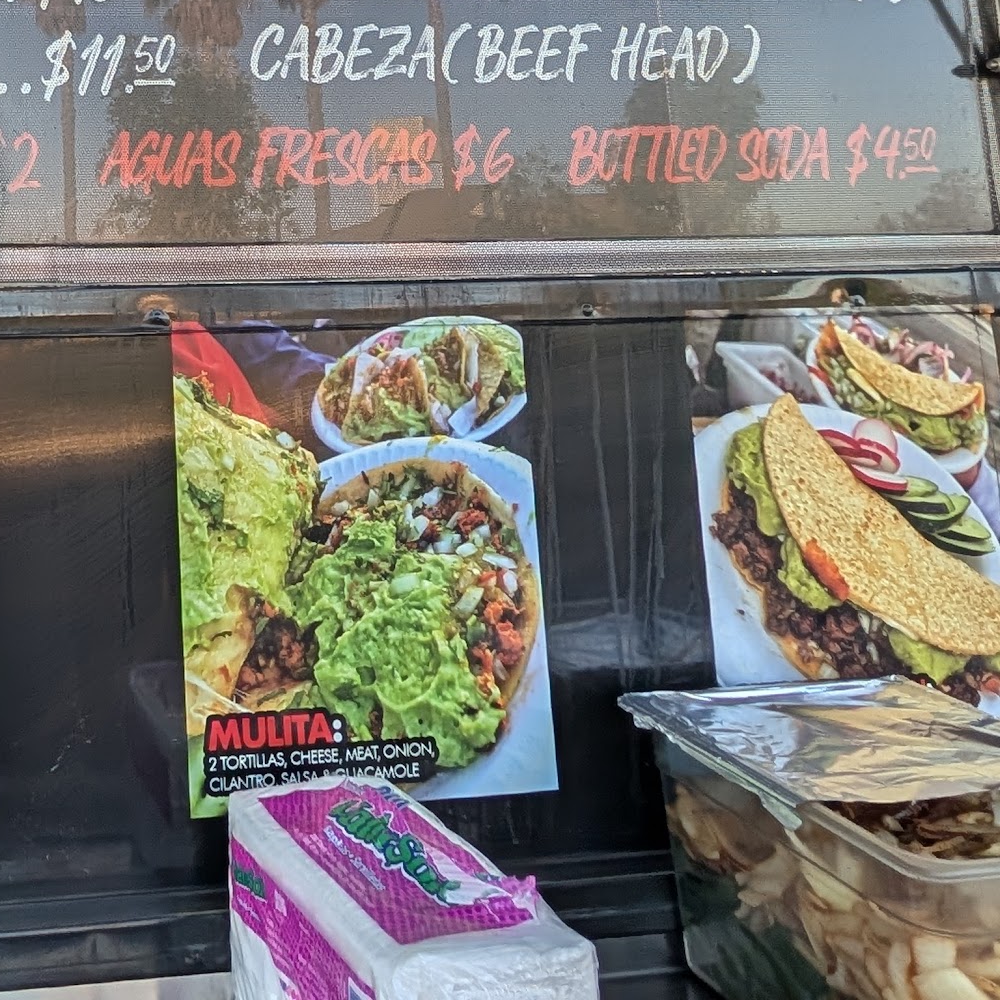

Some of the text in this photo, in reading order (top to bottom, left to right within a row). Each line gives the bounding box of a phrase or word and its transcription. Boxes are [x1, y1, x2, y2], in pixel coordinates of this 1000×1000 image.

[100, 128, 241, 194] AGUAS
[253, 124, 439, 191] FRESCAS
[569, 125, 728, 187] BOTTLED
[738, 126, 831, 181] SODA
[208, 712, 343, 751] MULITA:
[208, 741, 435, 772] 2 TORTILLAS, CHEESE, MEAT, ONION,
